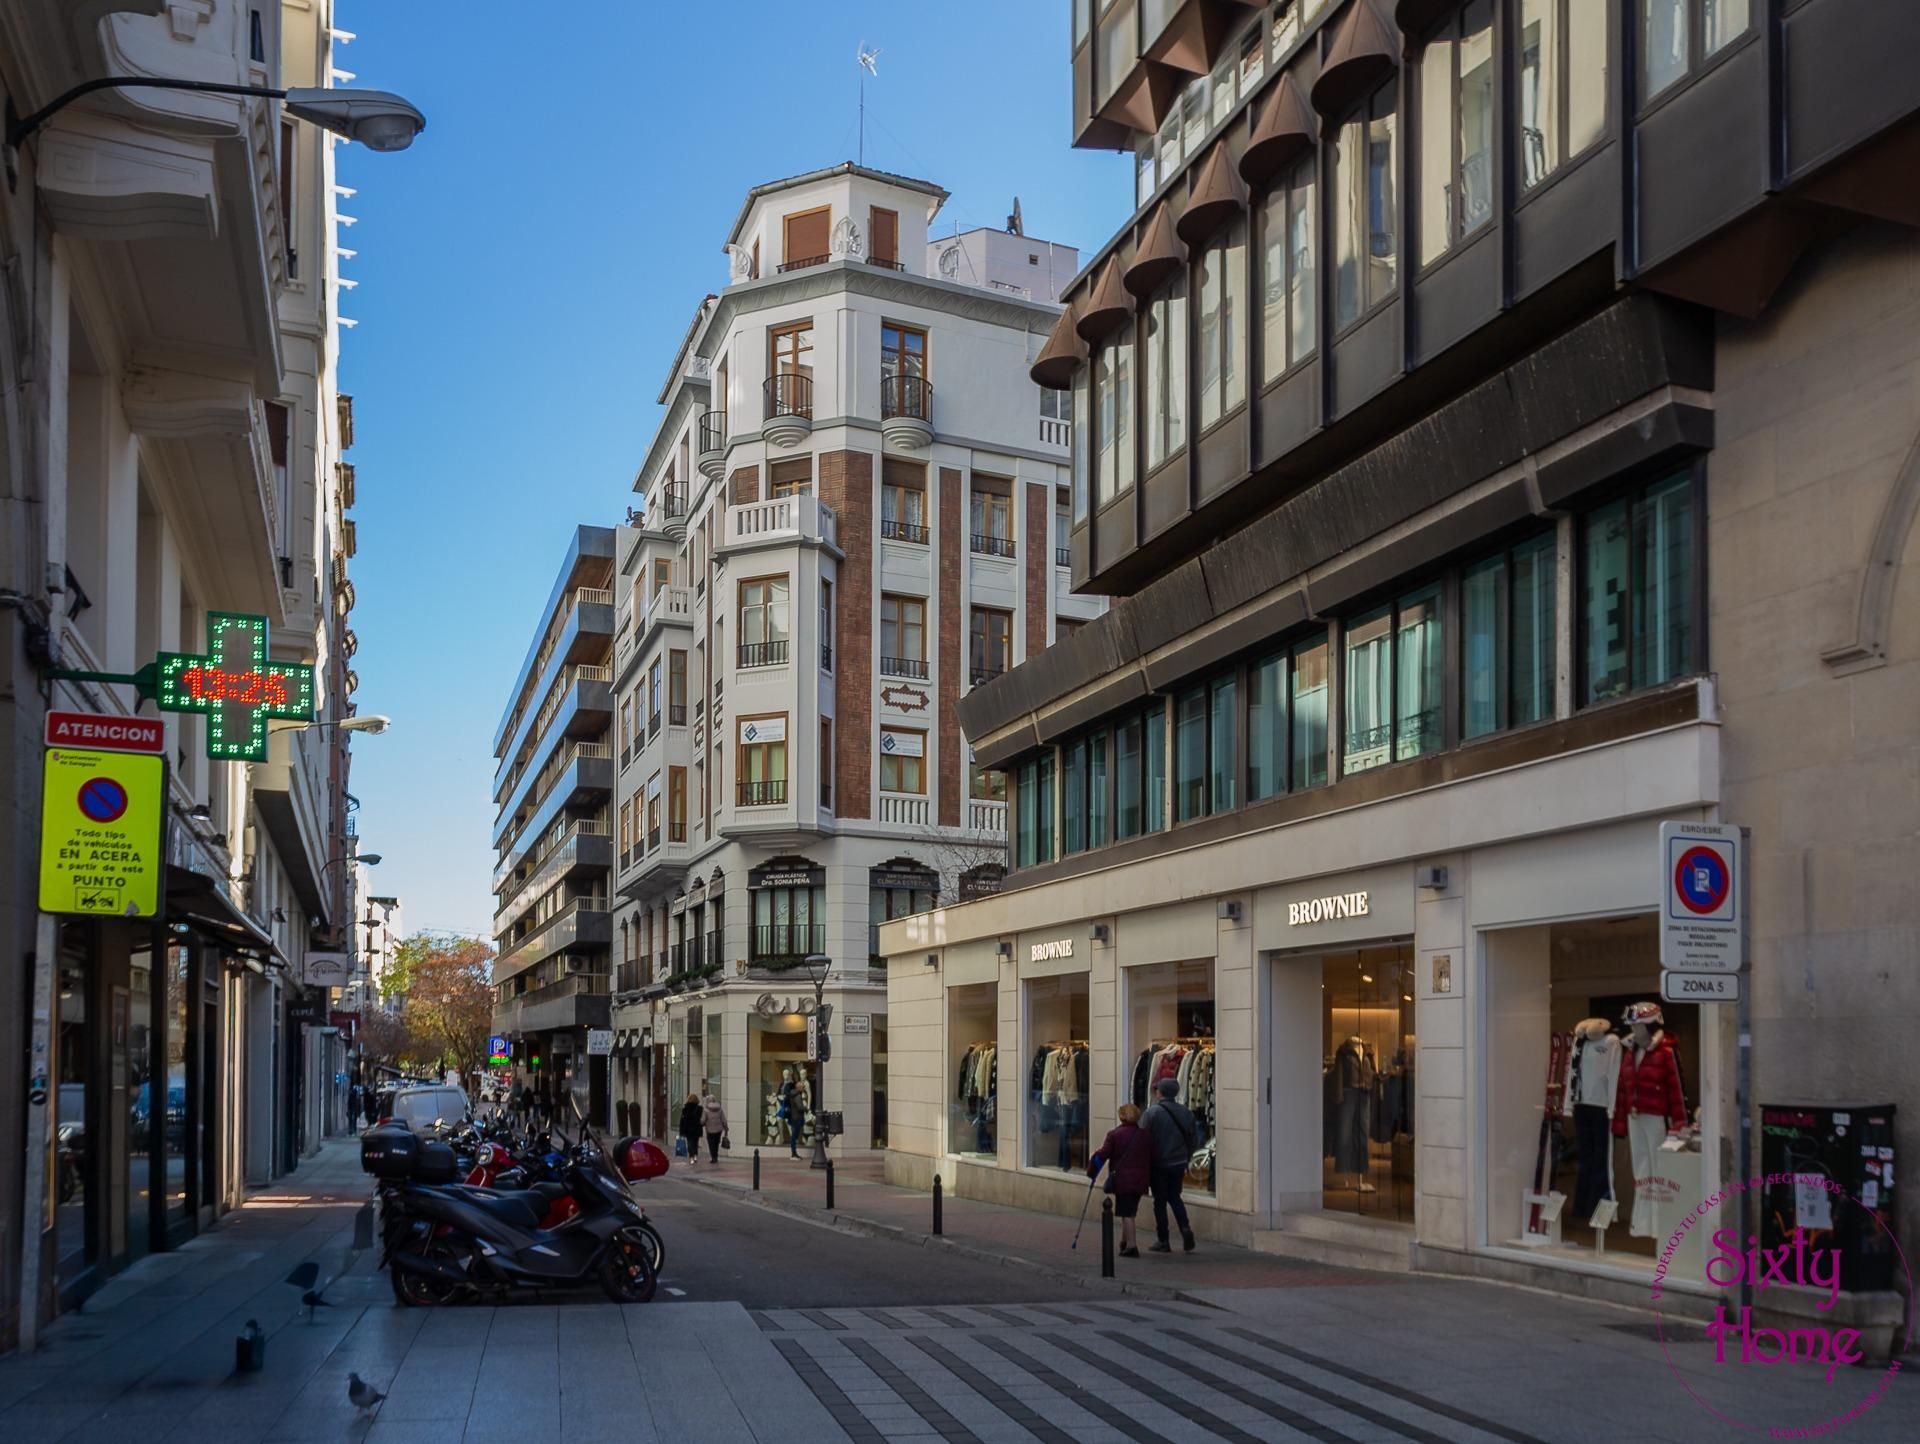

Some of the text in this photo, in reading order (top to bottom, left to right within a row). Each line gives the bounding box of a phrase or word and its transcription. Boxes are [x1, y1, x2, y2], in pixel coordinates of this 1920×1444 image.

[183, 666, 287, 705] 13:25
[56, 722, 156, 742] ATENCION
[75, 829, 126, 839] Todo tipo
[67, 839, 80, 847] de
[59, 848, 142, 862] EN ACERA
[68, 862, 97, 871] partir
[102, 864, 116, 872] de
[73, 875, 127, 887] PUNTO
[774, 878, 792, 886] SONIA
[1288, 890, 1369, 926] BROWNIE
[1031, 938, 1074, 962] BROWNIE
[1683, 980, 1724, 993] ZONA 5
